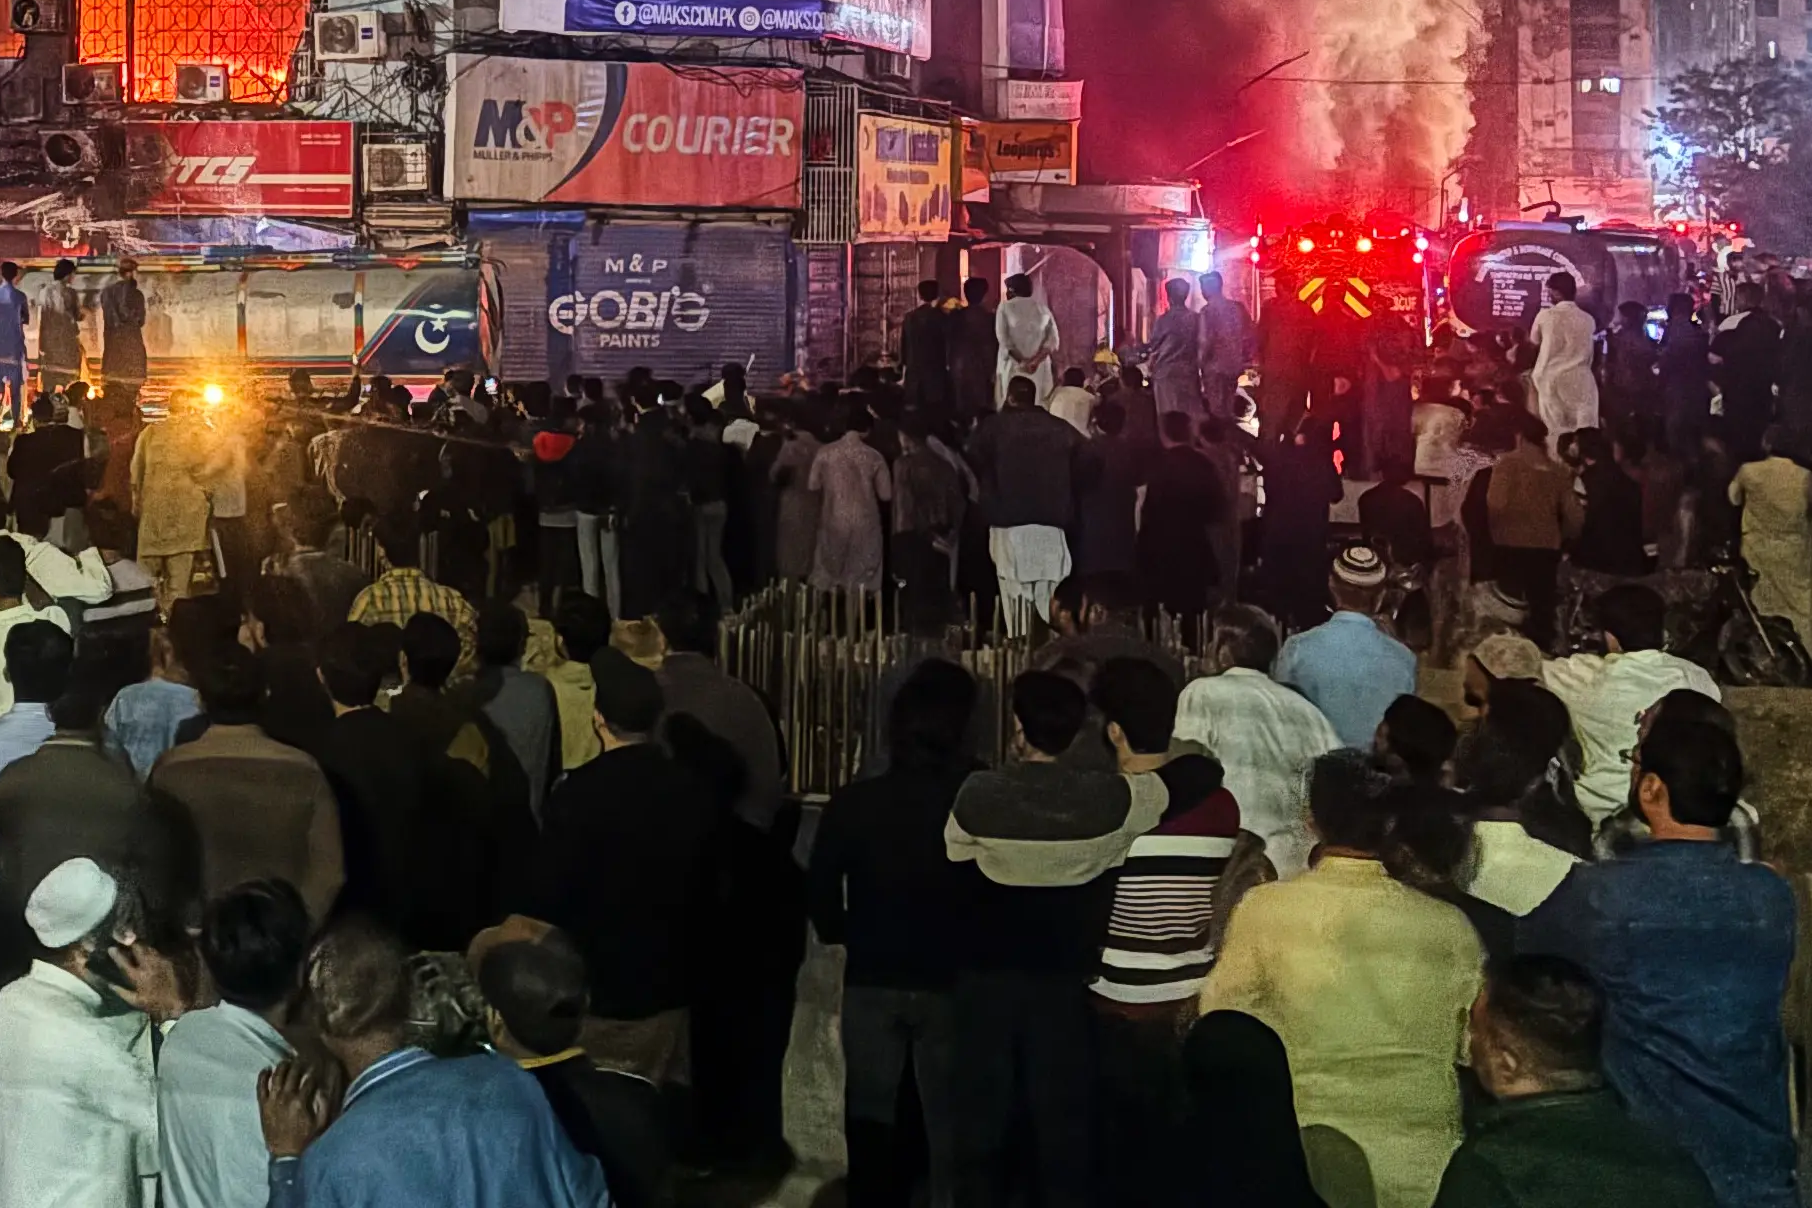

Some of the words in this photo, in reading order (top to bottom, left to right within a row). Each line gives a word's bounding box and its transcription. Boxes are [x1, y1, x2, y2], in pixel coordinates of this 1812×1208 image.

[474, 98, 576, 149] M&P
[622, 112, 793, 157] COURIER
[473, 149, 510, 161] MULLER
[175, 156, 257, 185] TCS
[604, 257, 624, 274] M
[628, 253, 643, 273] &
[651, 259, 668, 274] P
[599, 333, 661, 348] PAINTS
